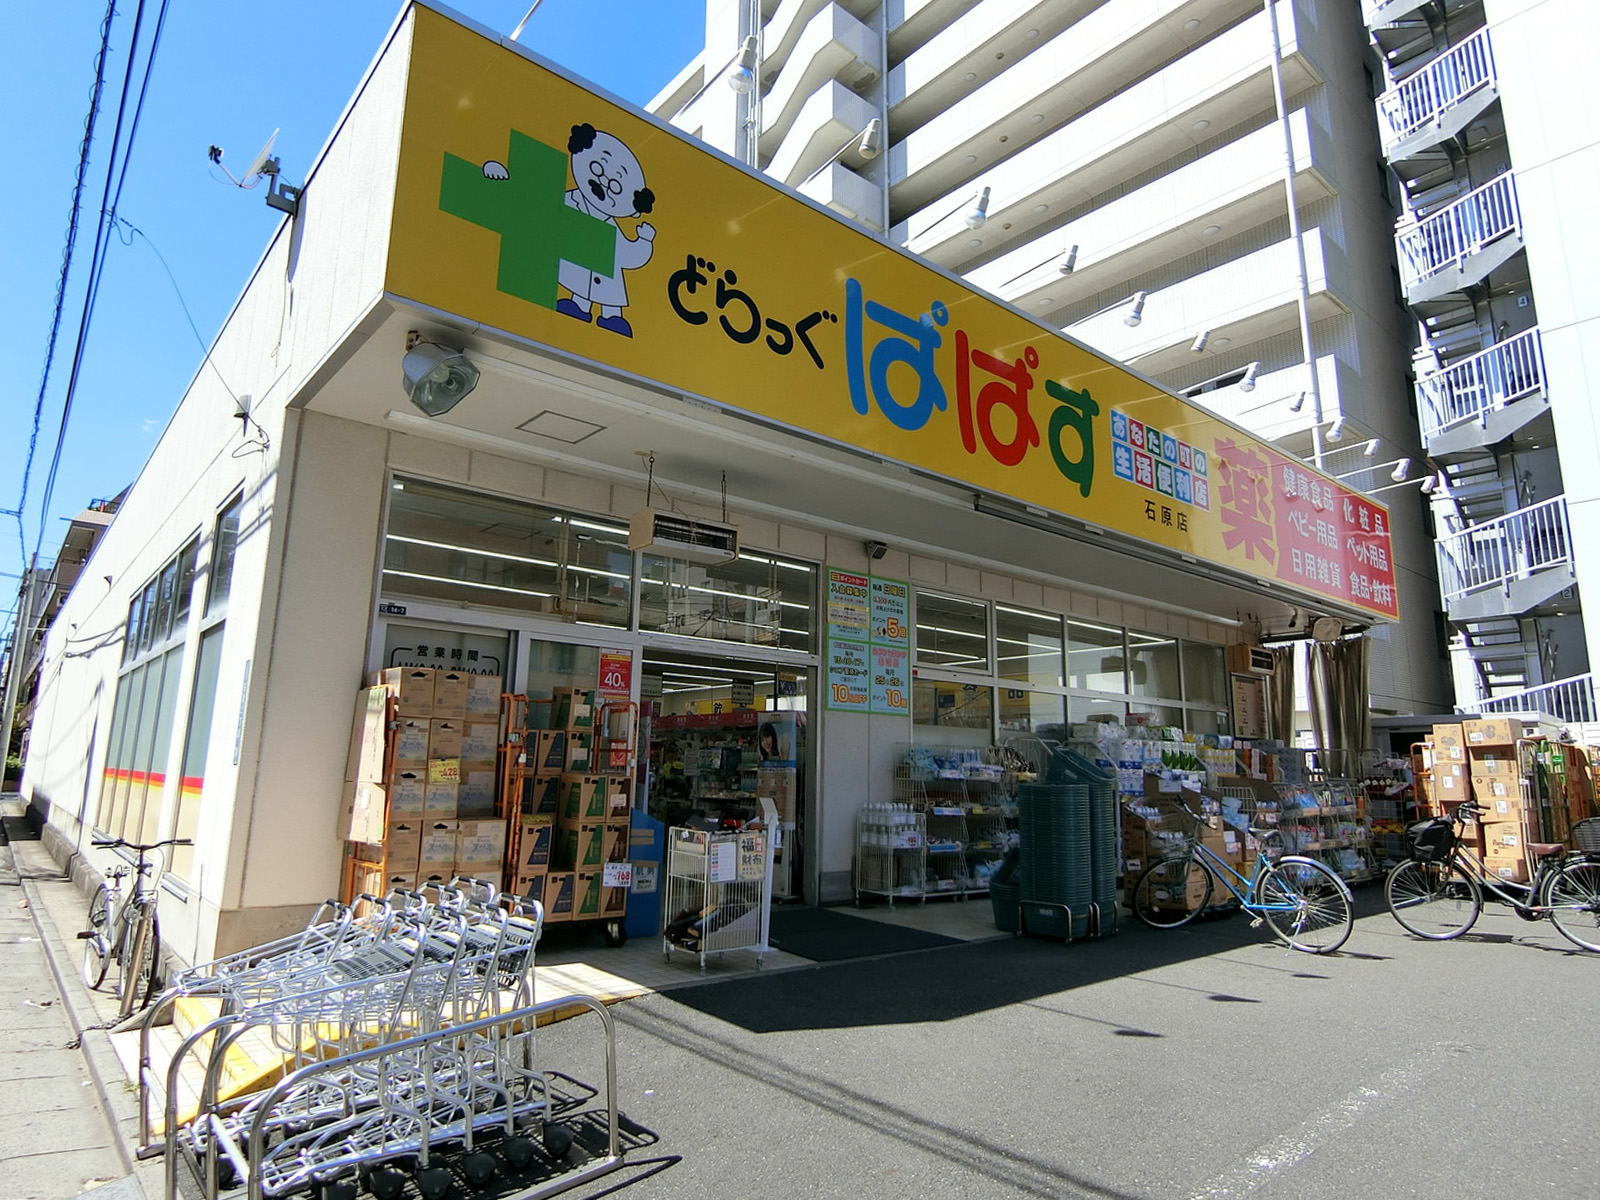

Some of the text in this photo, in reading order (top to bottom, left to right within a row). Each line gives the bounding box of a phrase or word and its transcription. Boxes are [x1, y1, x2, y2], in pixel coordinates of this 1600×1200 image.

[667, 254, 1100, 498] どらっぐ ぱぱす
[1112, 414, 1206, 473] あなたの町の
[1114, 446, 1208, 506] 生活便利店
[1283, 465, 1334, 512] 健康食品
[1144, 499, 1188, 533] 石原店
[1214, 436, 1276, 567] 薬
[1343, 497, 1384, 537] 化粧品
[1288, 510, 1339, 550] ベビー用品
[1291, 547, 1342, 589] 日用雑貨
[1347, 536, 1389, 572] ペット用品
[1349, 570, 1392, 608] 食品・飲料
[417, 645, 479, 662] 営業時間
